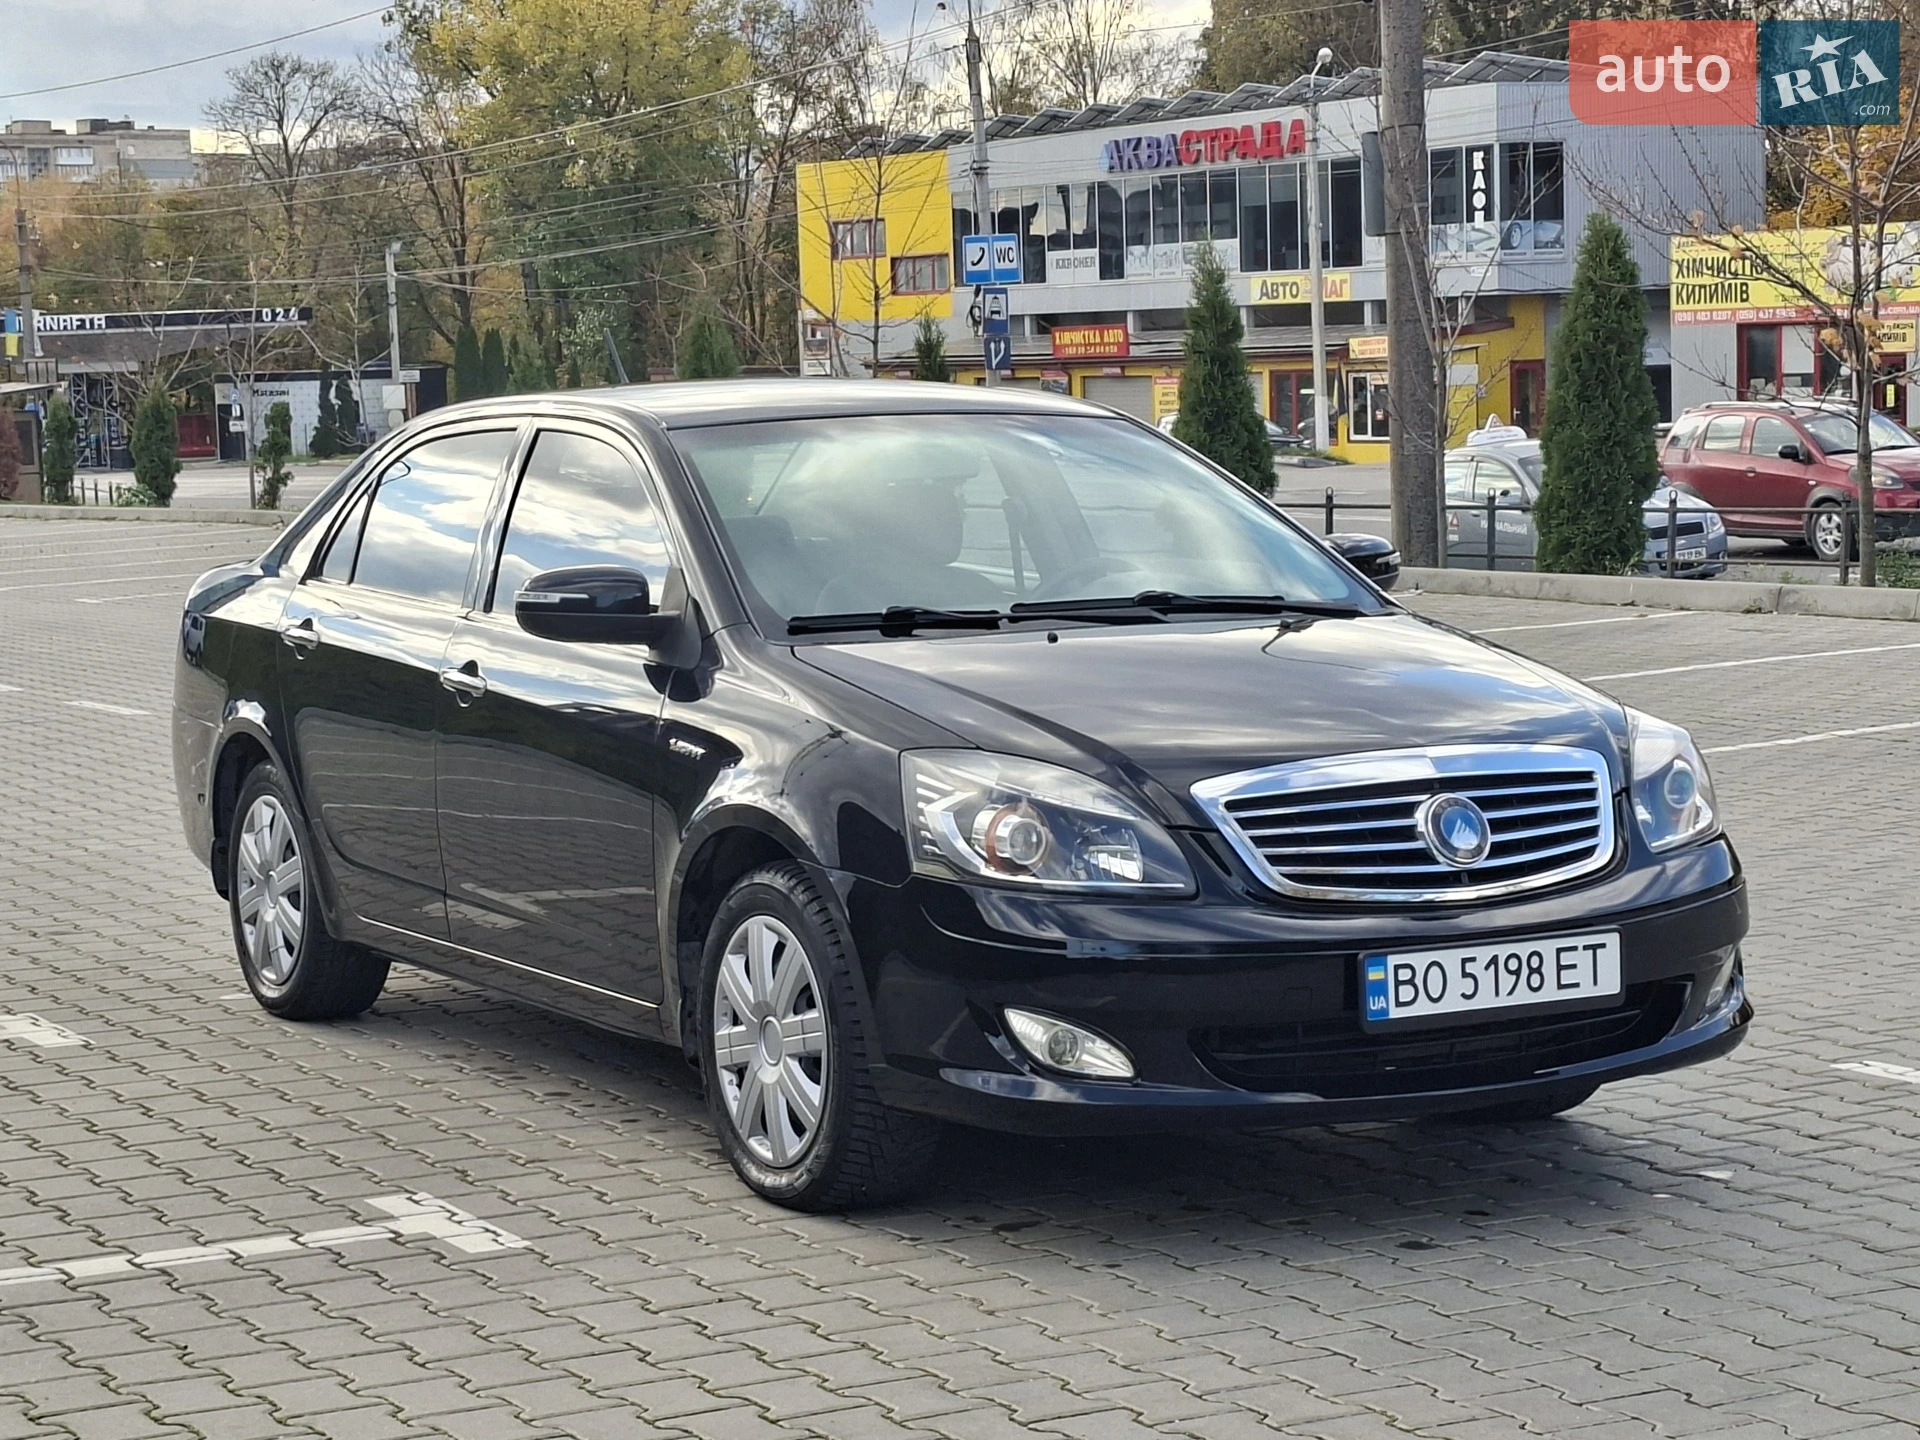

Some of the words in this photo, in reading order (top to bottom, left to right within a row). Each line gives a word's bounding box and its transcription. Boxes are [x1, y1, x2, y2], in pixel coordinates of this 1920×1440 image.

[1106, 118, 1306, 173] АКВАСТРАДА
[995, 246, 1015, 264] WC
[1675, 281, 1750, 306] КИЛИМІВ
[1393, 960, 1448, 1008] BO
[1460, 949, 1545, 1001] 5198
[1555, 942, 1607, 991] ET
[1369, 996, 1387, 1011] UA
